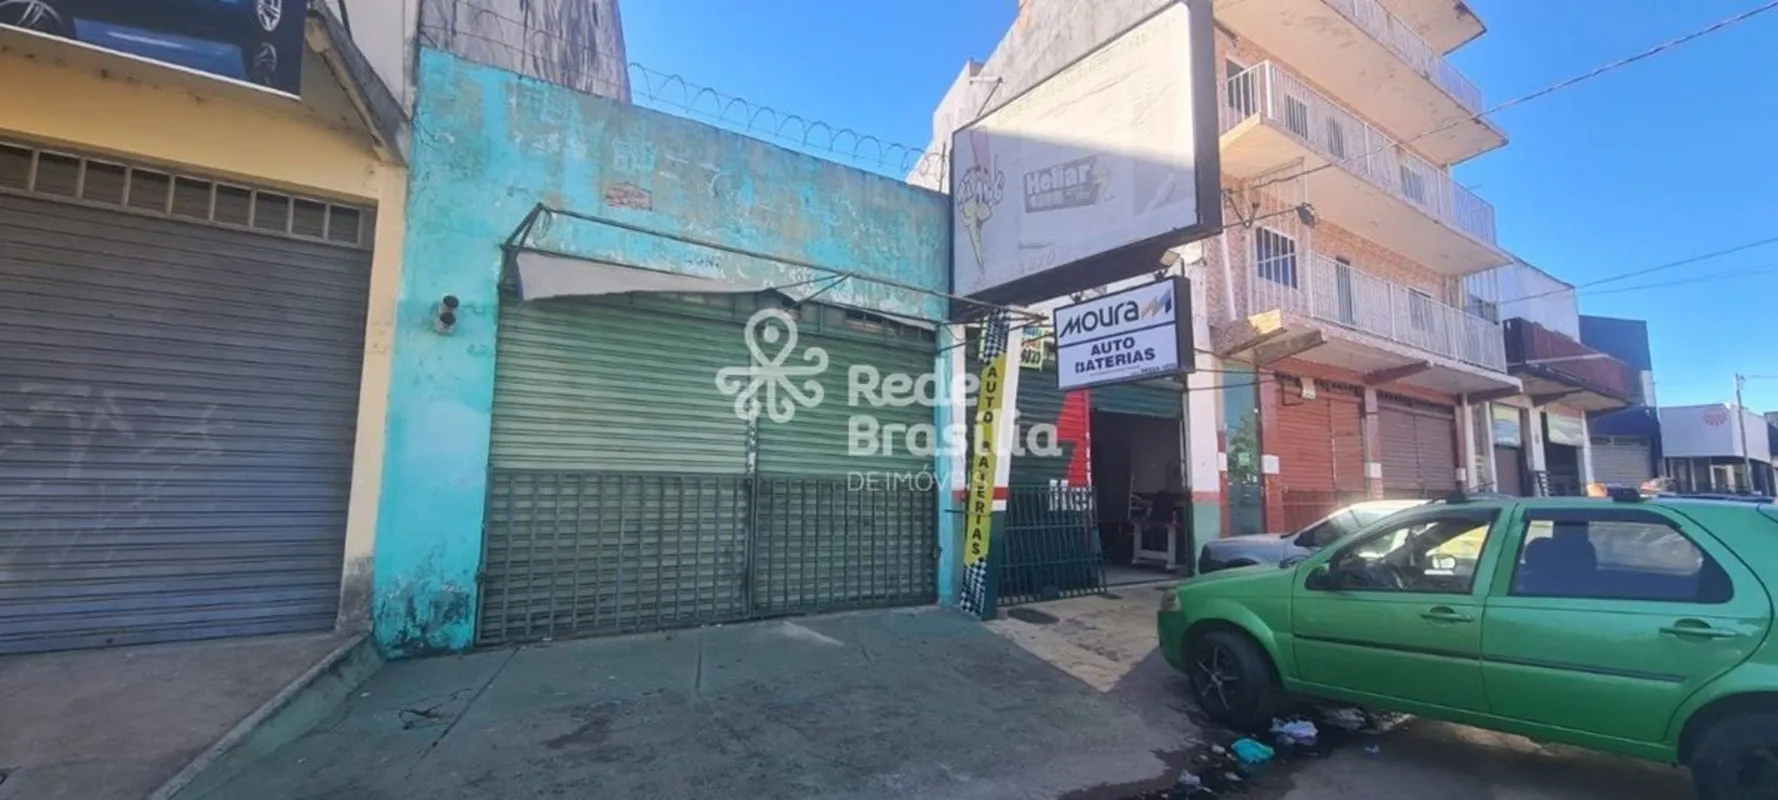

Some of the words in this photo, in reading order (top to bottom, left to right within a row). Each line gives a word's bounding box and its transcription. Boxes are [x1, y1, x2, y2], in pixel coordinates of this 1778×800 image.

[1090, 336, 1136, 356] AUTO
[1074, 347, 1157, 374] BATERIAS
[982, 366, 998, 424] AUTO
